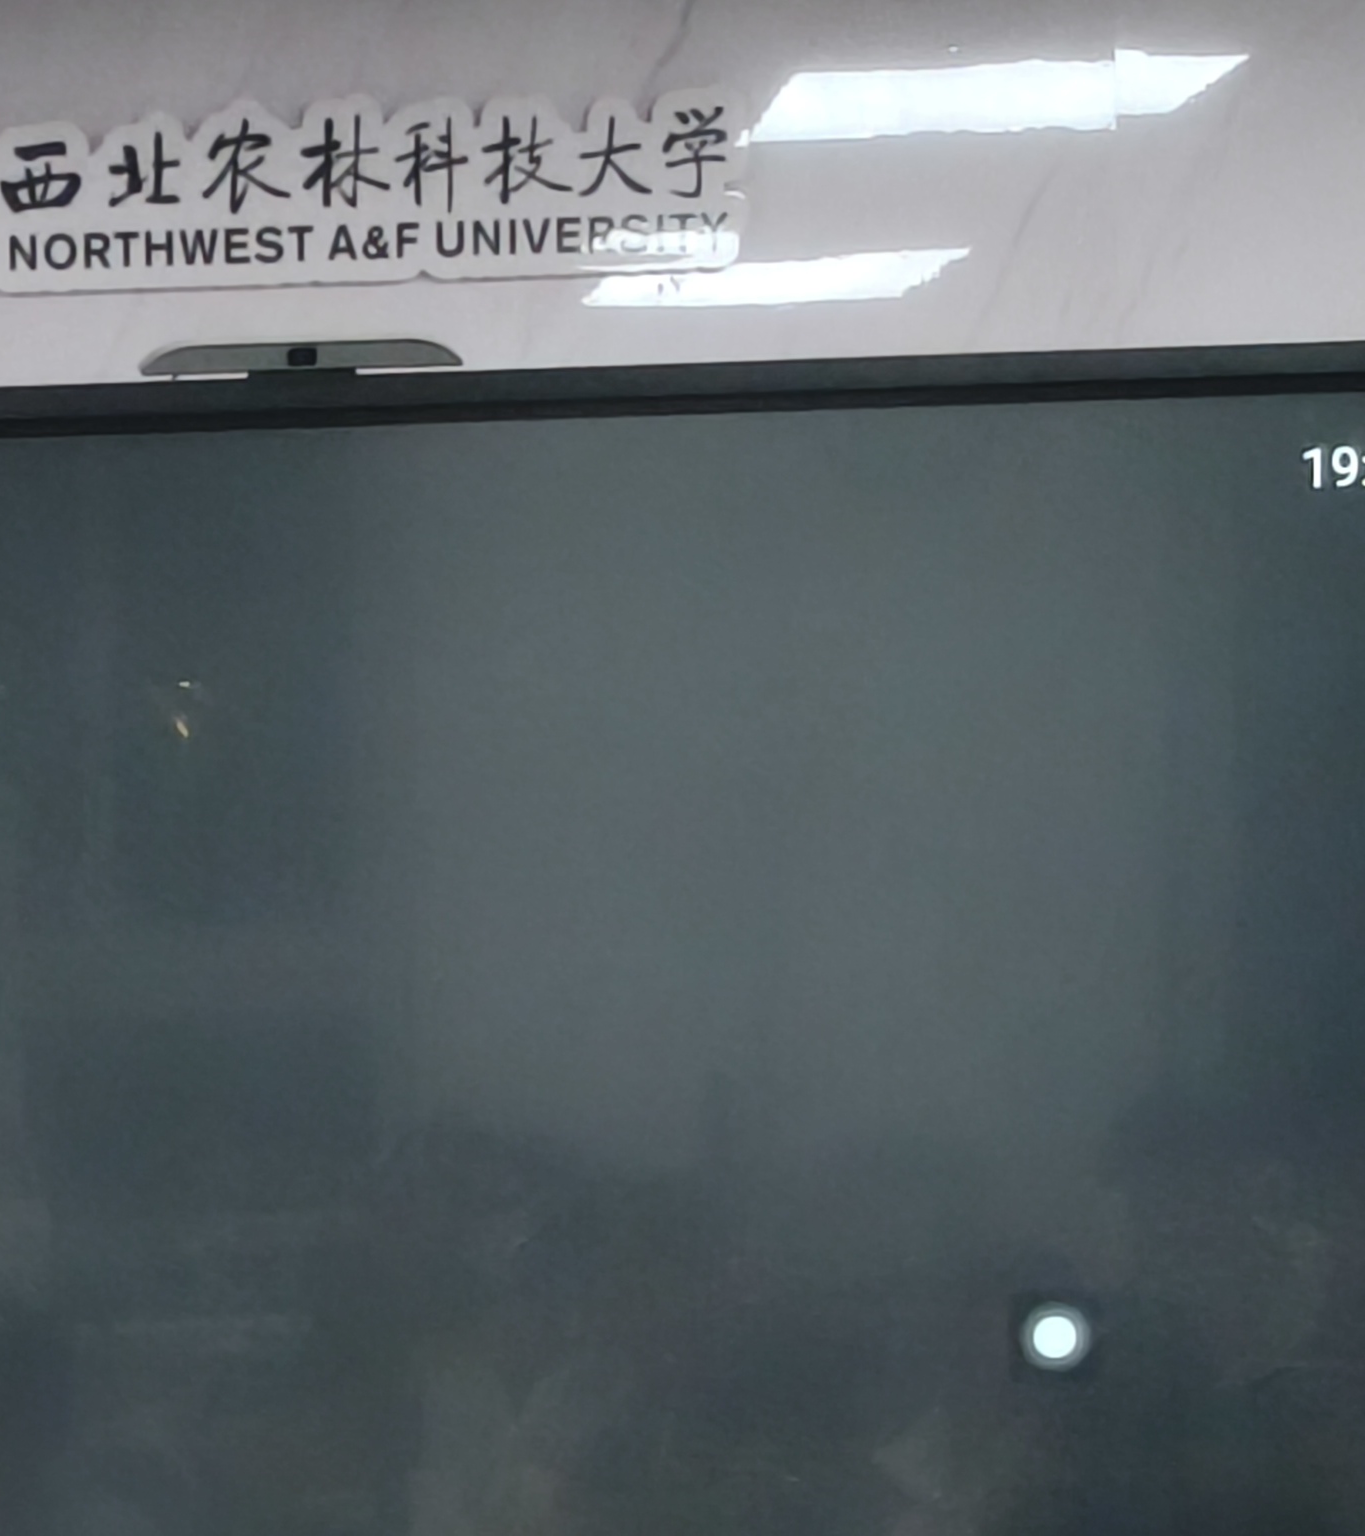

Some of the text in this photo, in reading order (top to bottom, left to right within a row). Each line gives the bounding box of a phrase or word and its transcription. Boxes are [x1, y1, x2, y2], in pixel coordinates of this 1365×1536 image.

[0, 105, 728, 214] 西北农林科技大学
[9, 224, 314, 271] NORTHWEST
[327, 222, 420, 261] A&F
[435, 210, 728, 258] UNIVERSITY
